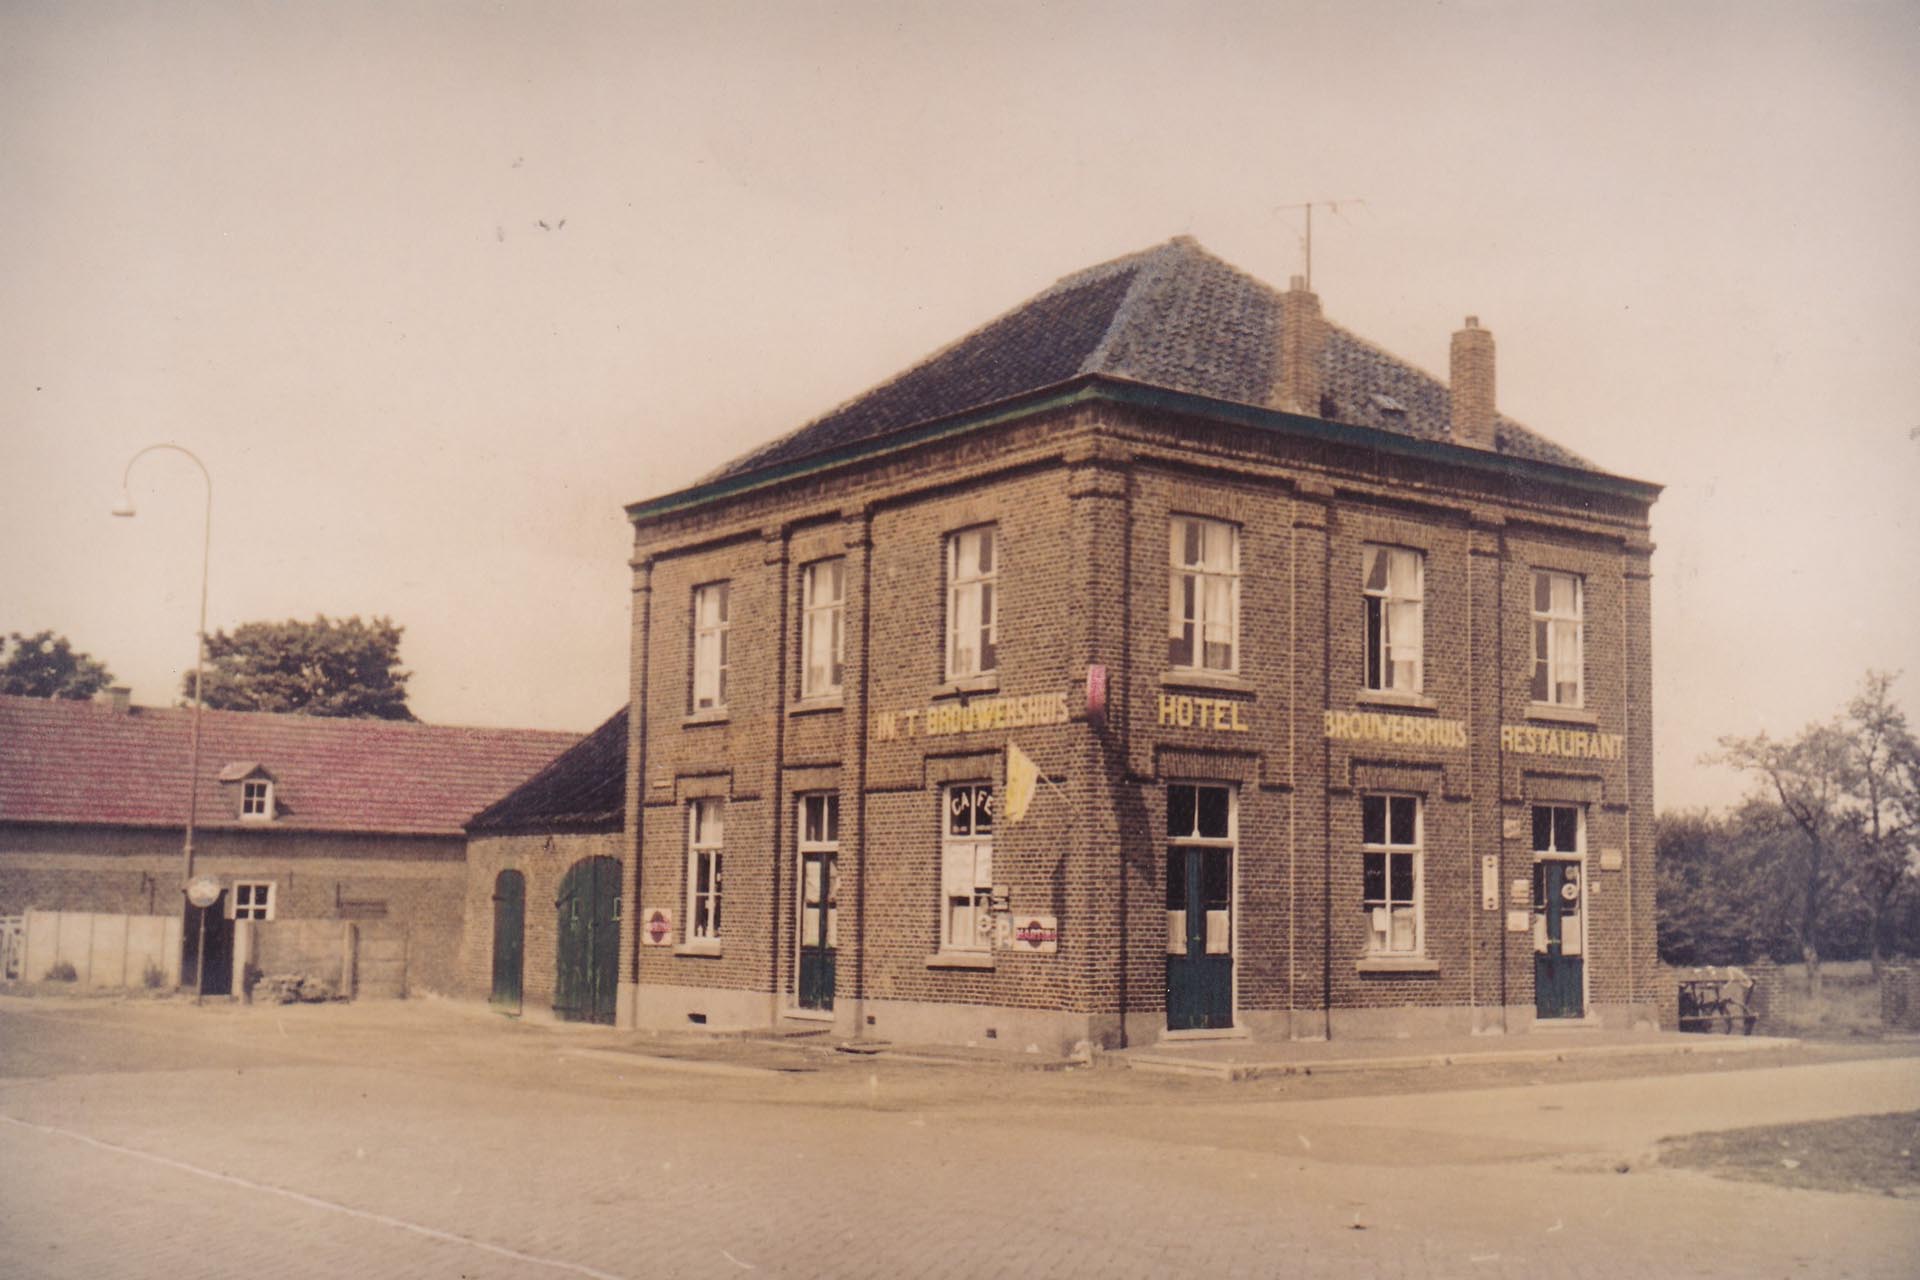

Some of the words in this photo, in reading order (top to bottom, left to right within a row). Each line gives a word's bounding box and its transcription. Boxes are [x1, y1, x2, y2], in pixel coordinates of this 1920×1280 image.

[926, 692, 1070, 735] BROUWERSHUIS
[1158, 694, 1249, 732] HOTEL
[1324, 710, 1467, 748] BROUWERSHUIS
[1501, 725, 1624, 760] RESTAURANT
[951, 790, 993, 816] CAFE
